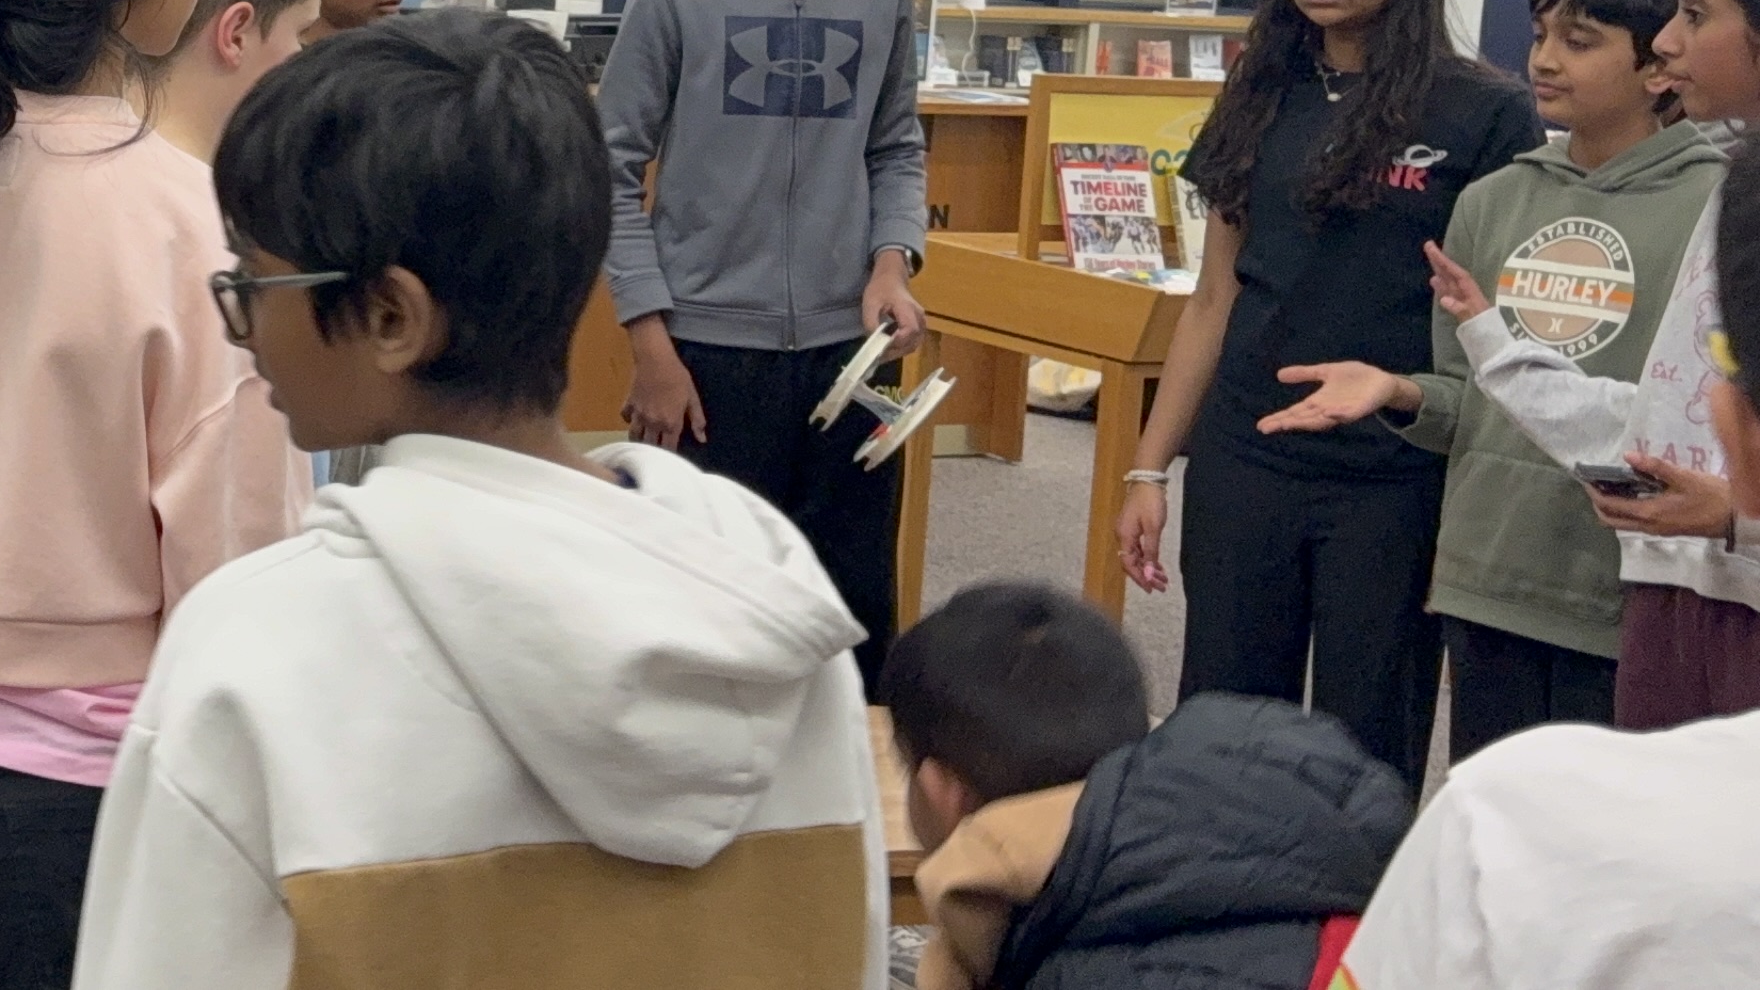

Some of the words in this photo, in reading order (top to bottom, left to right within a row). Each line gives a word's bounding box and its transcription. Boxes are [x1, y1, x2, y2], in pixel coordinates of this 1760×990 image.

[1070, 180, 1147, 198] TIMELINE
[1094, 197, 1146, 213] GAME
[1527, 222, 1624, 262] ESTABLISHED
[1511, 270, 1617, 307] HURLEY
